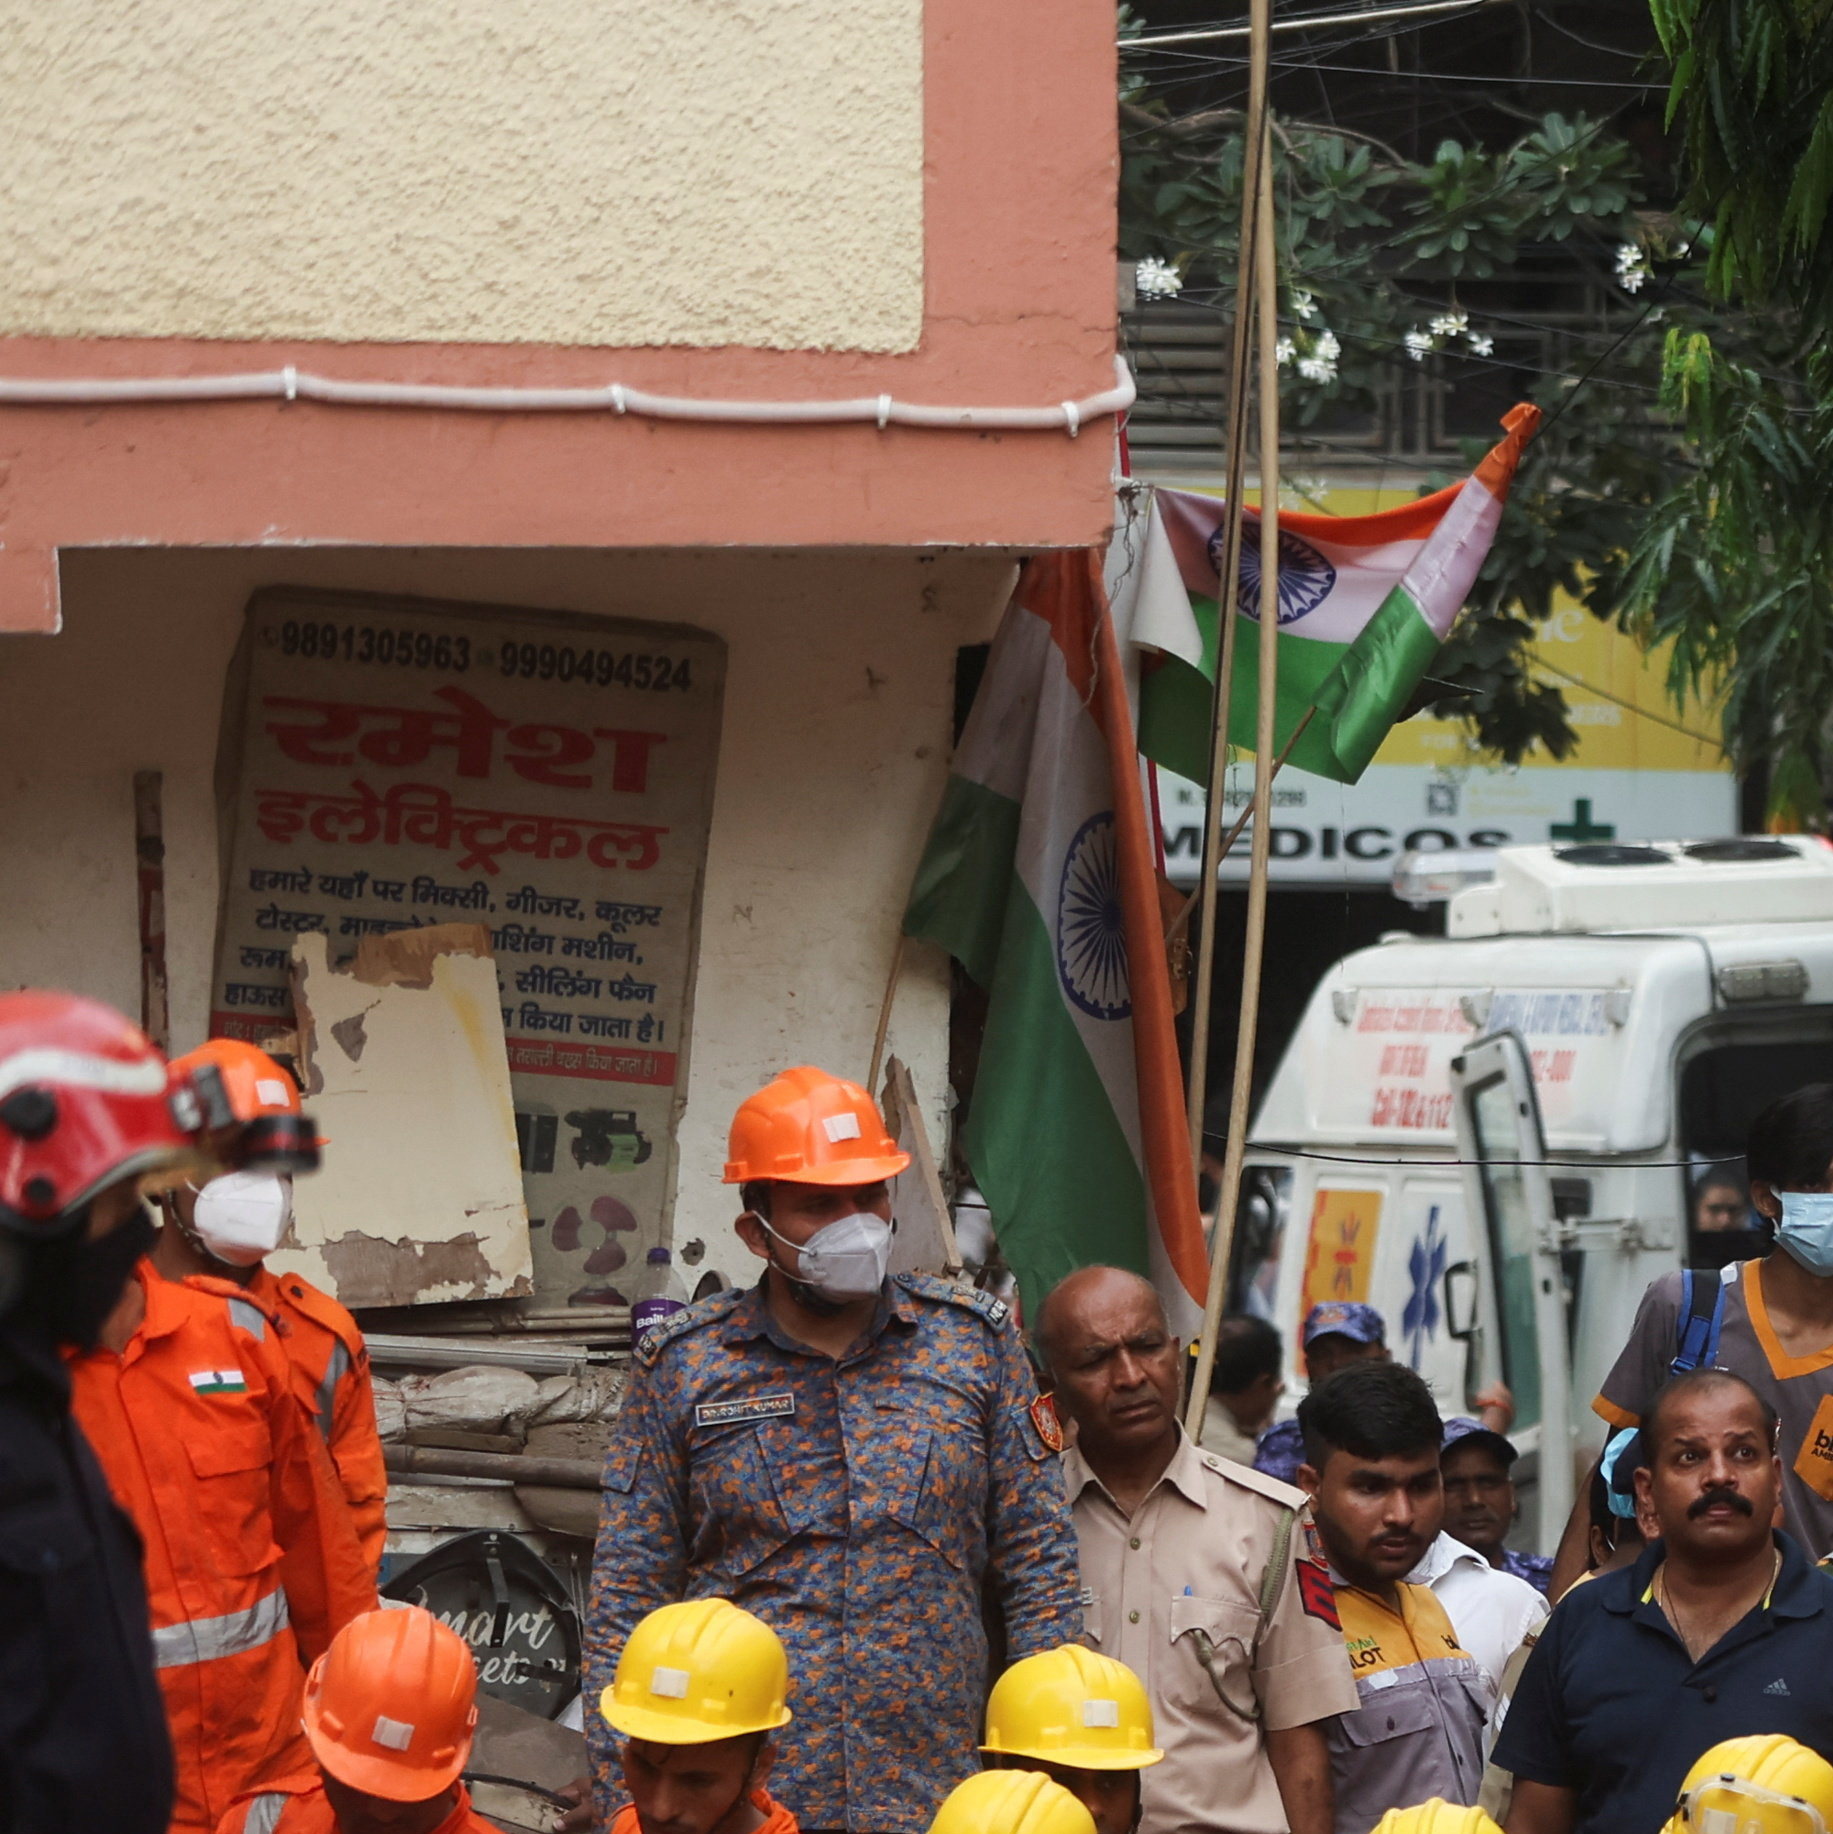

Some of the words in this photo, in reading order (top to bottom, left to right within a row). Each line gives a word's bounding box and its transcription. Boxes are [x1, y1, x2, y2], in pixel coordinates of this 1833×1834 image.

[282, 621, 470, 673] 9891305963
[500, 643, 692, 693] 9990494524
[262, 685, 667, 793] रमेश
[254, 779, 670, 876] इलेक्ट्रिकल
[372, 880, 406, 903] पर
[595, 900, 663, 934] कूलर
[562, 931, 643, 965] मशीन,
[515, 964, 602, 998] सीलिंग
[609, 973, 657, 1004] फैन
[520, 1001, 572, 1034] किया
[579, 1014, 632, 1040] जाता
[1348, 1646, 1386, 1669] ILOT
